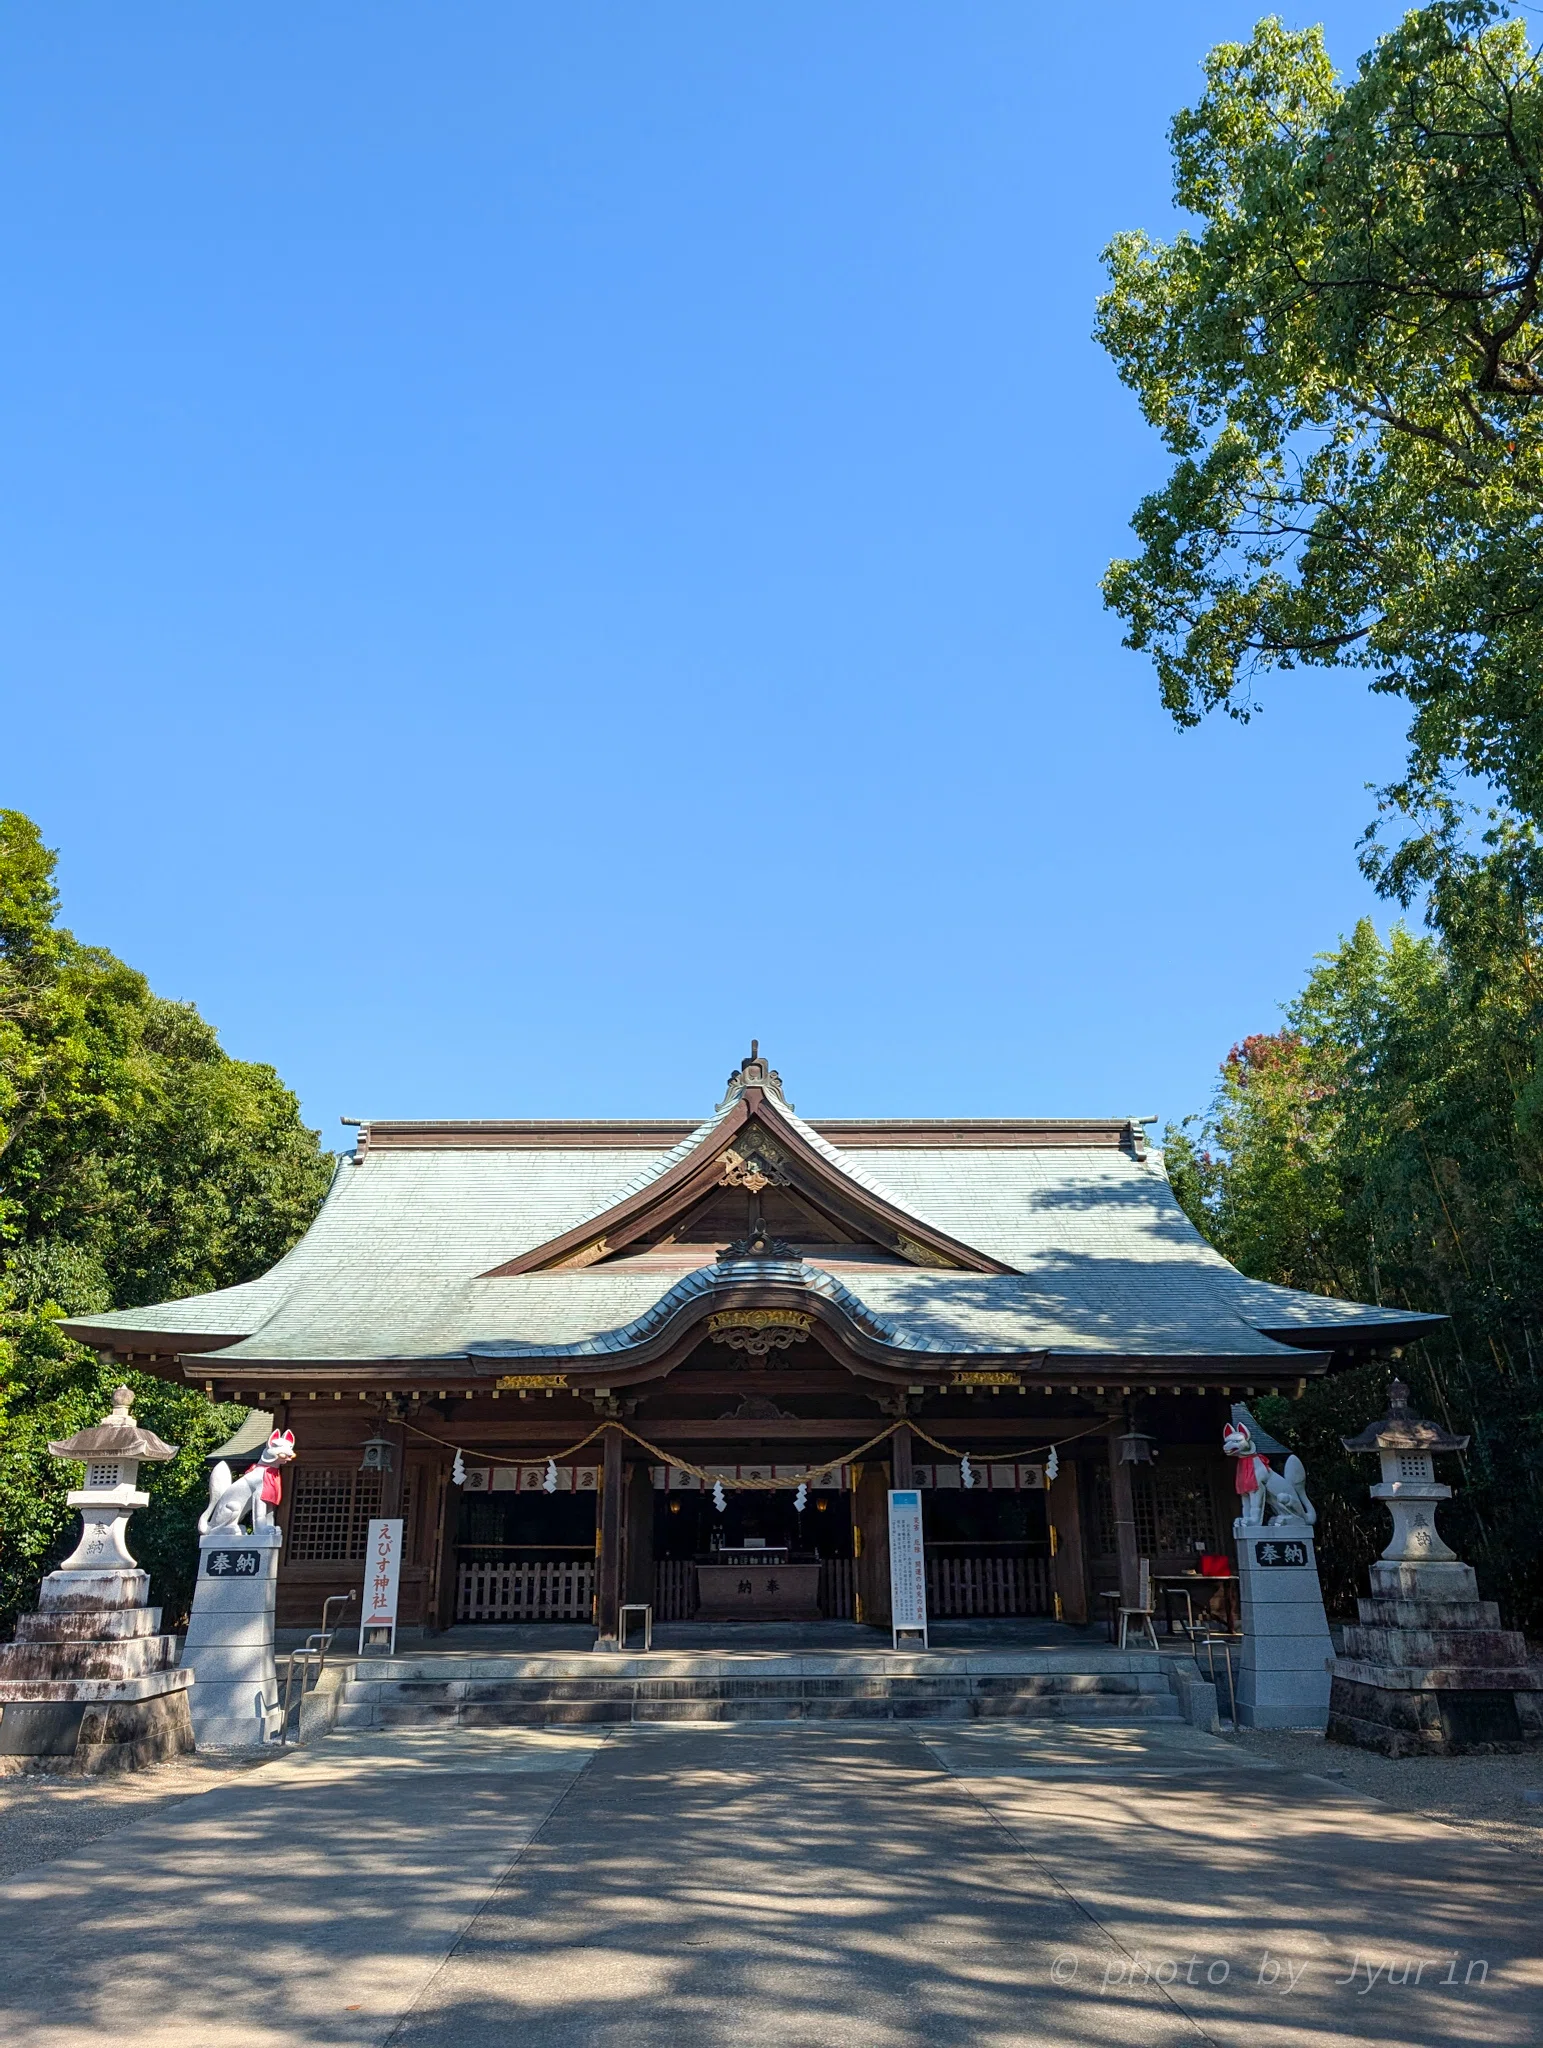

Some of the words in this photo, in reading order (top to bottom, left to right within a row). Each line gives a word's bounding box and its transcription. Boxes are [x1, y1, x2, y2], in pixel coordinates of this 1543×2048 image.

[86, 1523, 107, 1555] 奉納
[1412, 1512, 1433, 1547] 奉納
[210, 1552, 256, 1575] 奉納
[372, 1523, 394, 1610] えびす神社
[1260, 1543, 1304, 1565] 奉納
